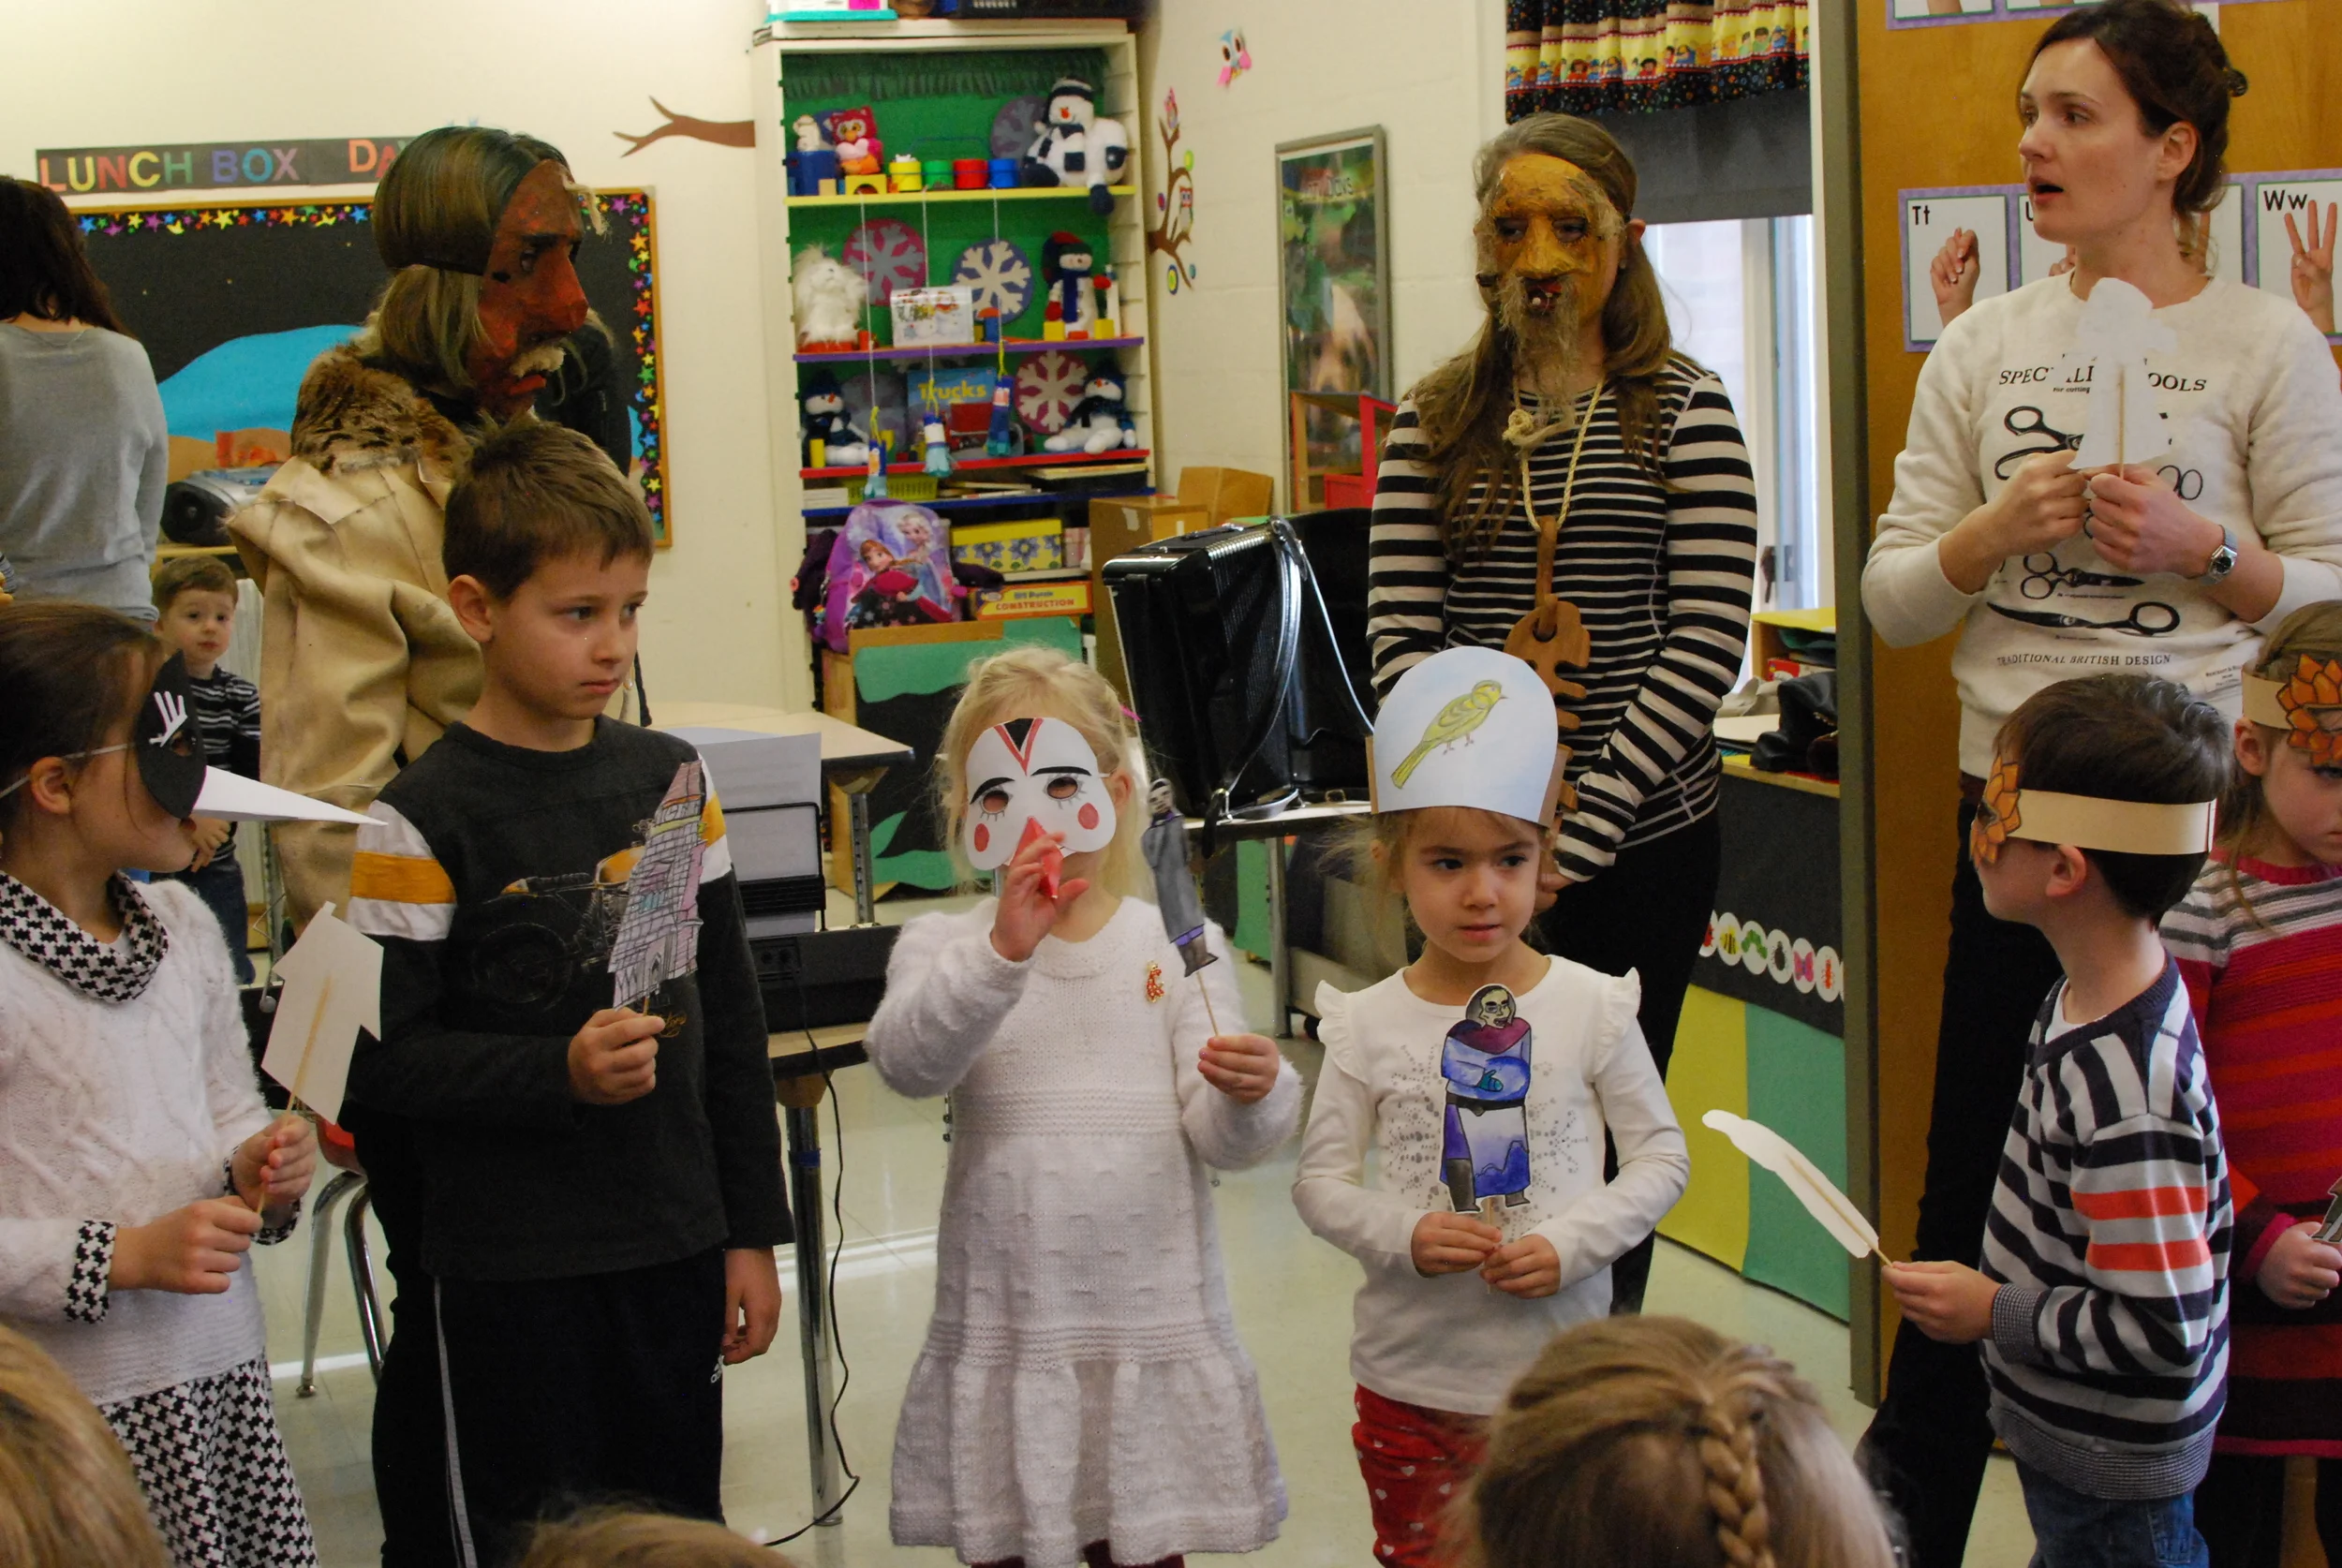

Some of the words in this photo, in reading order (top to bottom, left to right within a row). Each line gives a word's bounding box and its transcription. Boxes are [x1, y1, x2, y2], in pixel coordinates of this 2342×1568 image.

[38, 151, 194, 192] LUNCH
[211, 148, 301, 183] BOX
[918, 379, 987, 400] Trucks
[2148, 372, 2207, 392] OOLS
[996, 599, 1075, 611] CONSTRUCTION
[1996, 653, 2067, 667] TRADITIONAL
[2069, 655, 2120, 666] BRITISH
[2125, 654, 2172, 666] DESIGN
